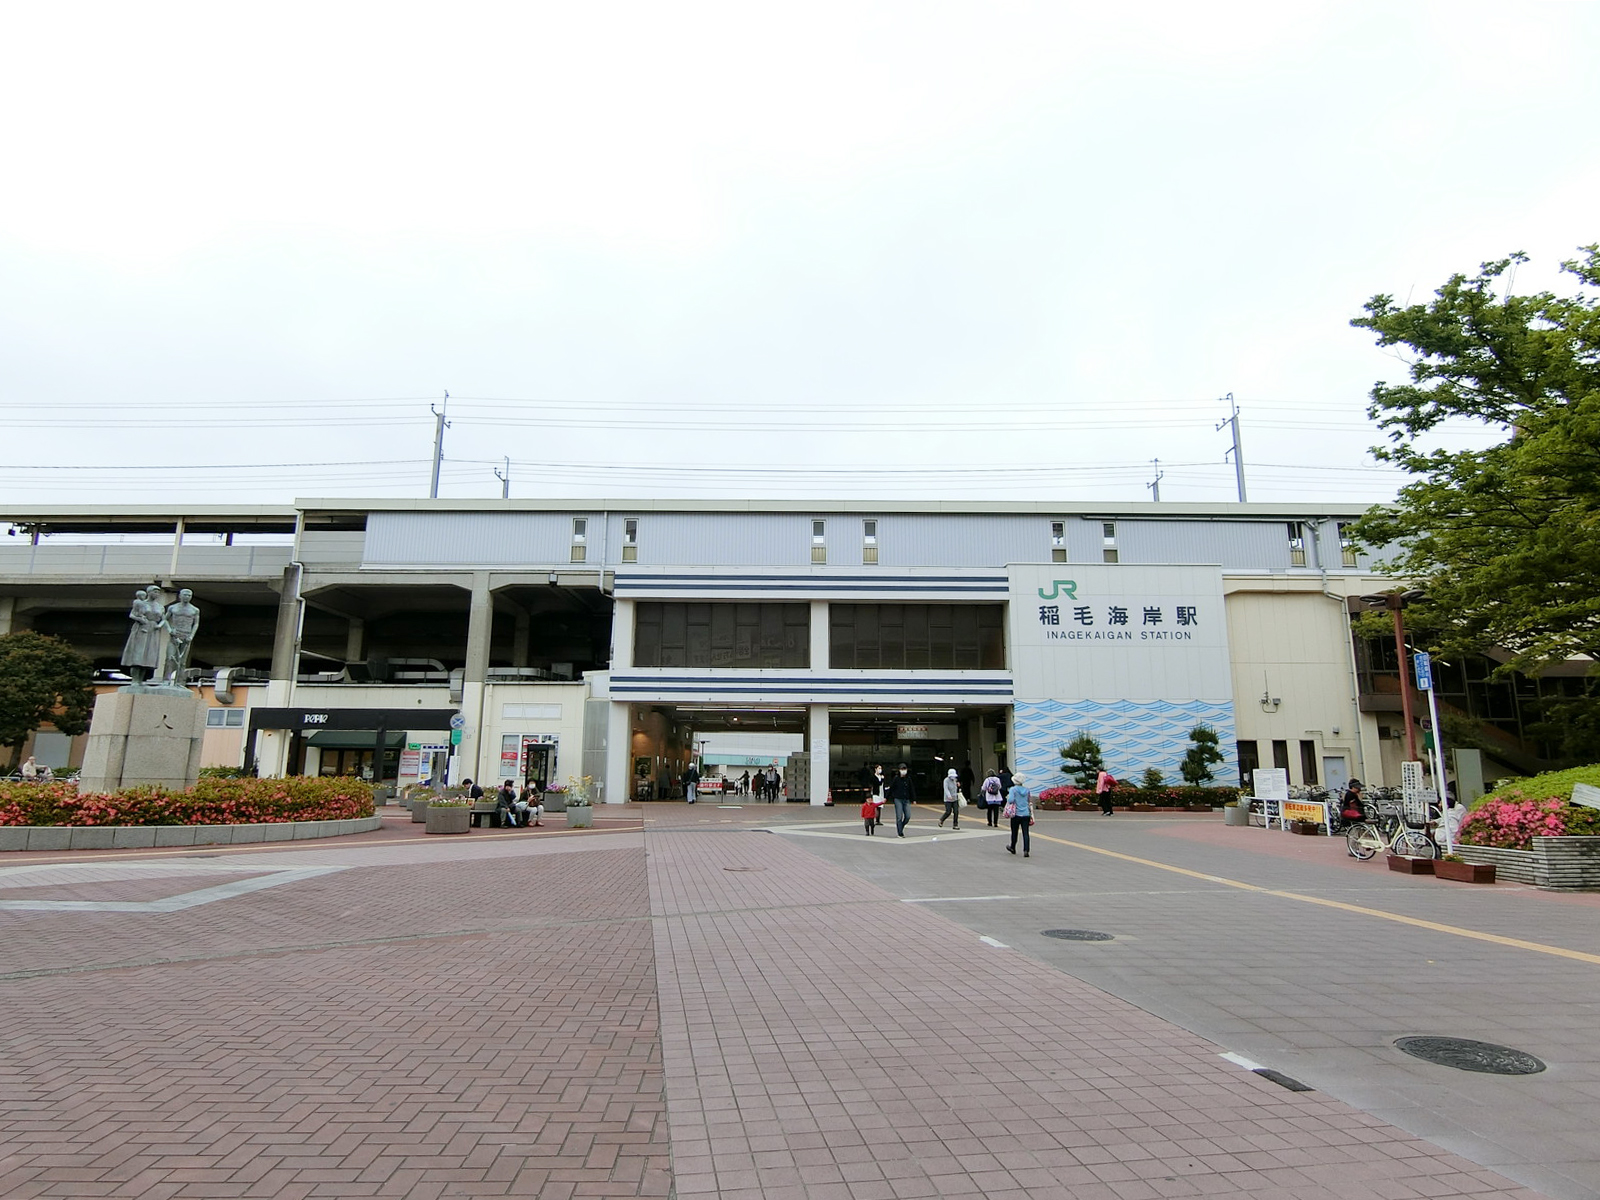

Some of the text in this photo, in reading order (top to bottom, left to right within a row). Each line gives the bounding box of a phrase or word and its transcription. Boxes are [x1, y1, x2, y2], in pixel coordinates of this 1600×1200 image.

[1038, 580, 1078, 600] JR
[1039, 605, 1198, 626] 稲毛海岸駅
[1046, 631, 1192, 640] INAGEKAIGAN STATION
